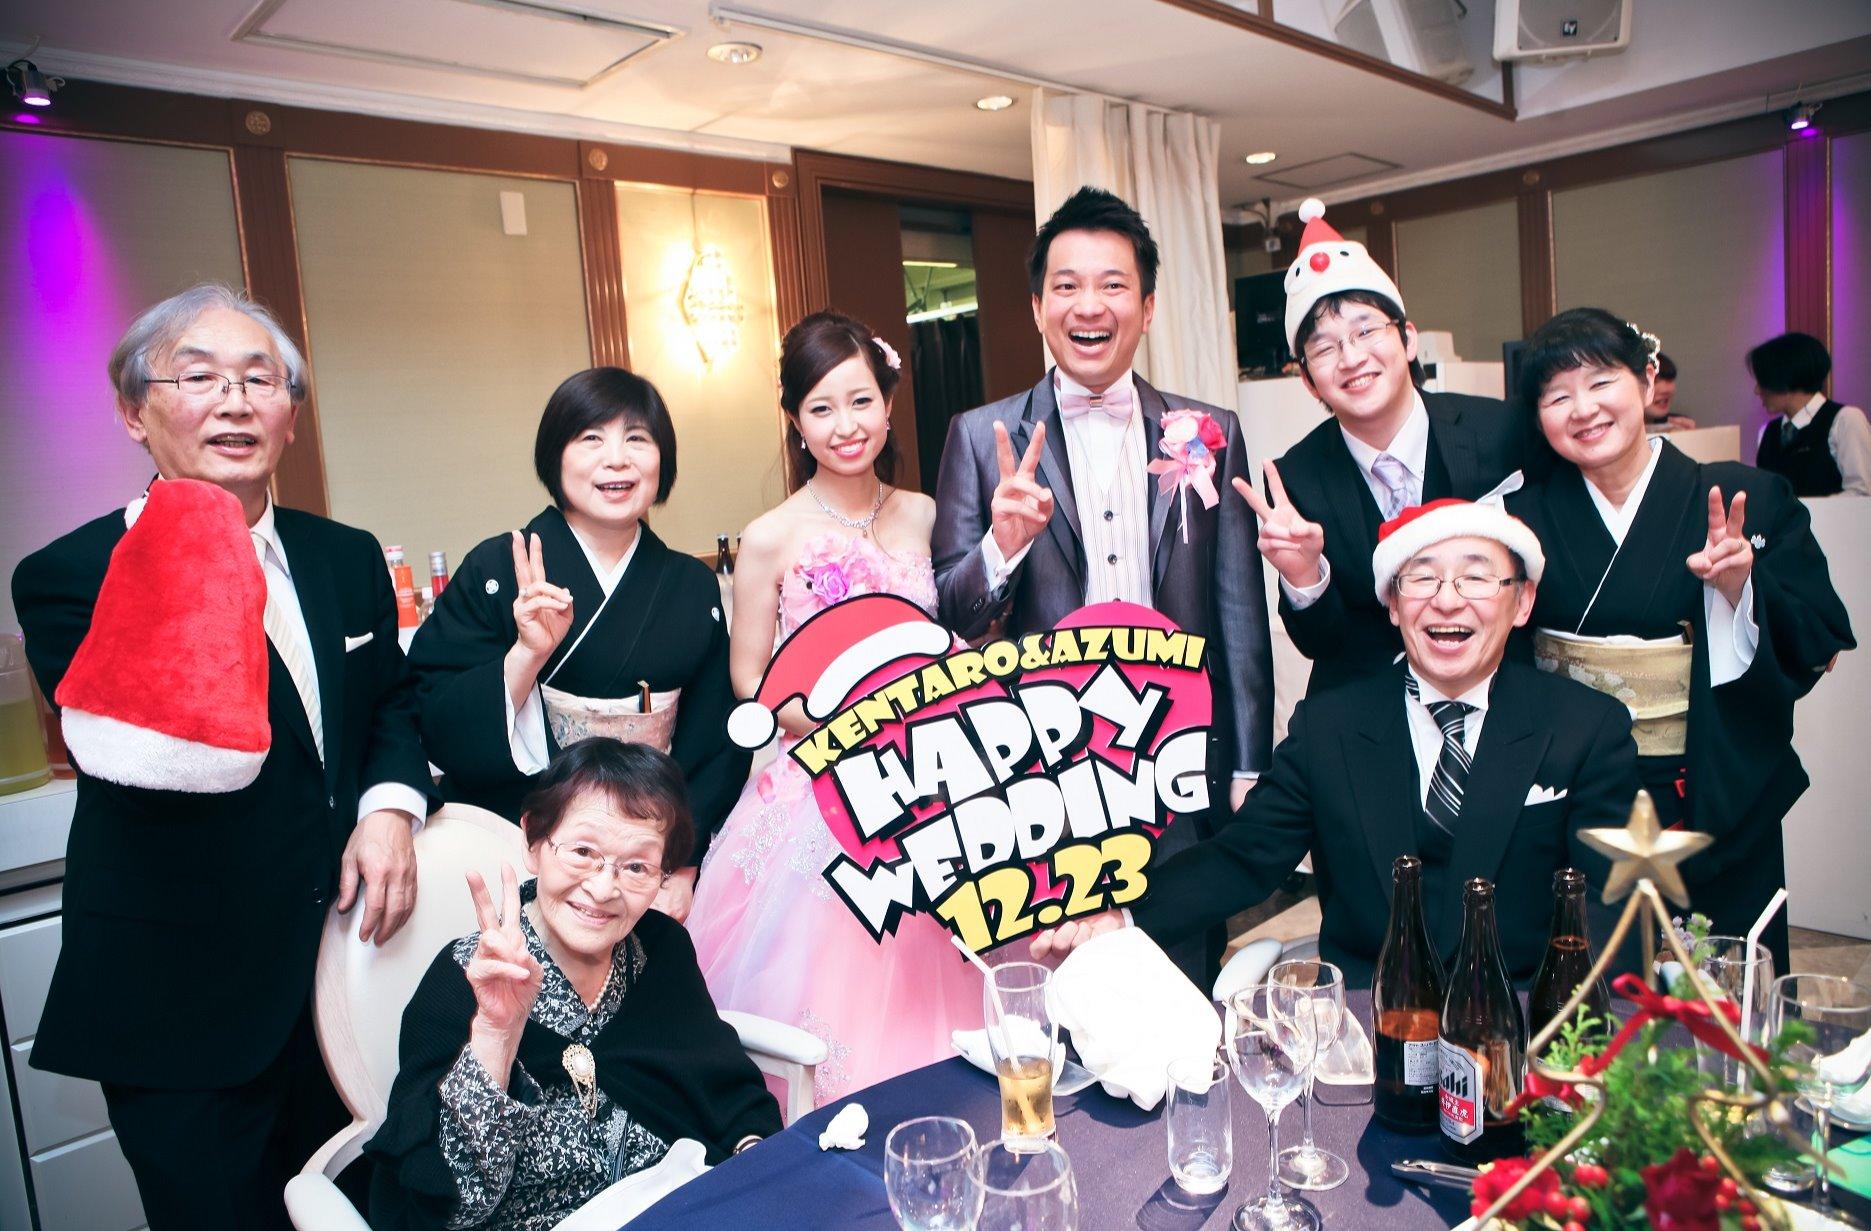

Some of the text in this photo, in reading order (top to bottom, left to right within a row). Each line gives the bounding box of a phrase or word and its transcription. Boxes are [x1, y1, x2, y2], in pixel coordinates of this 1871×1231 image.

[795, 627, 1206, 774] KENTARO&AZUMI
[833, 664, 1163, 838] HAPPY
[831, 731, 1210, 934] WEDDING
[936, 833, 1151, 951] 12.23
